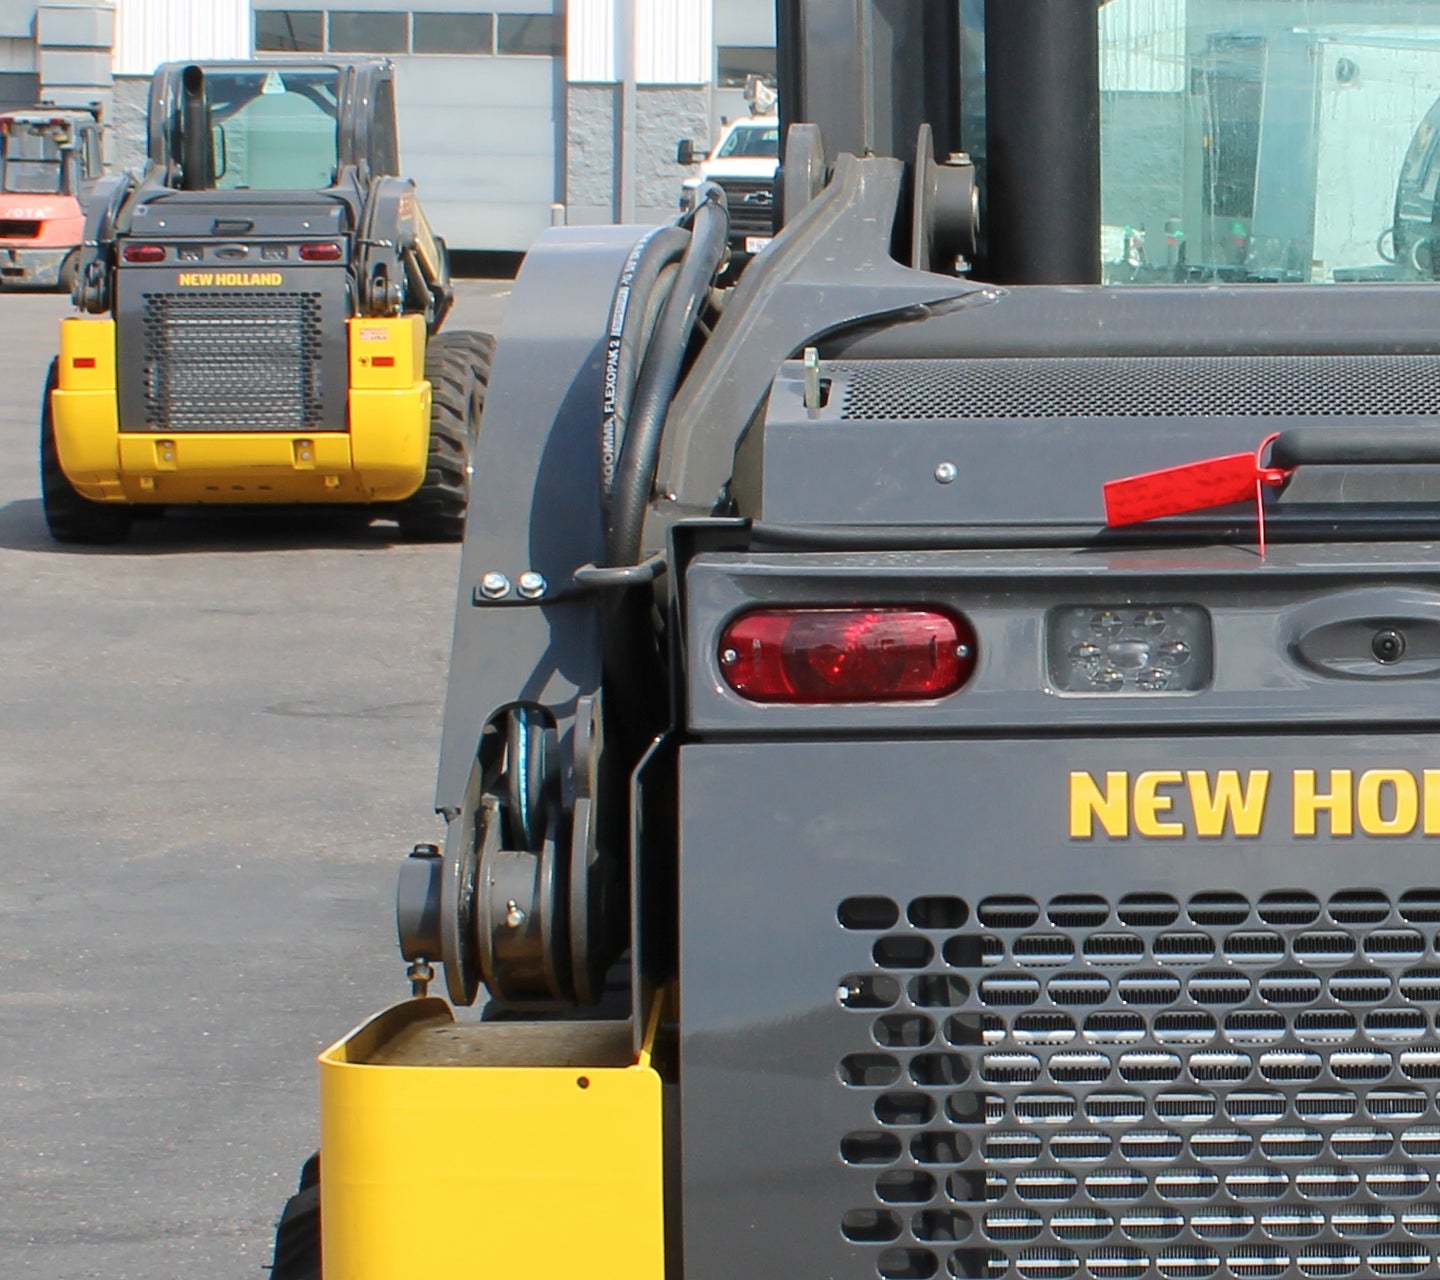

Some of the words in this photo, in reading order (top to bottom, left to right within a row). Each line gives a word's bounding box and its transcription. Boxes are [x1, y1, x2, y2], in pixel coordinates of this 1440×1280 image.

[178, 272, 213, 287] NEW
[215, 272, 283, 287] HOLLAND
[1069, 769, 1270, 837] NEW
